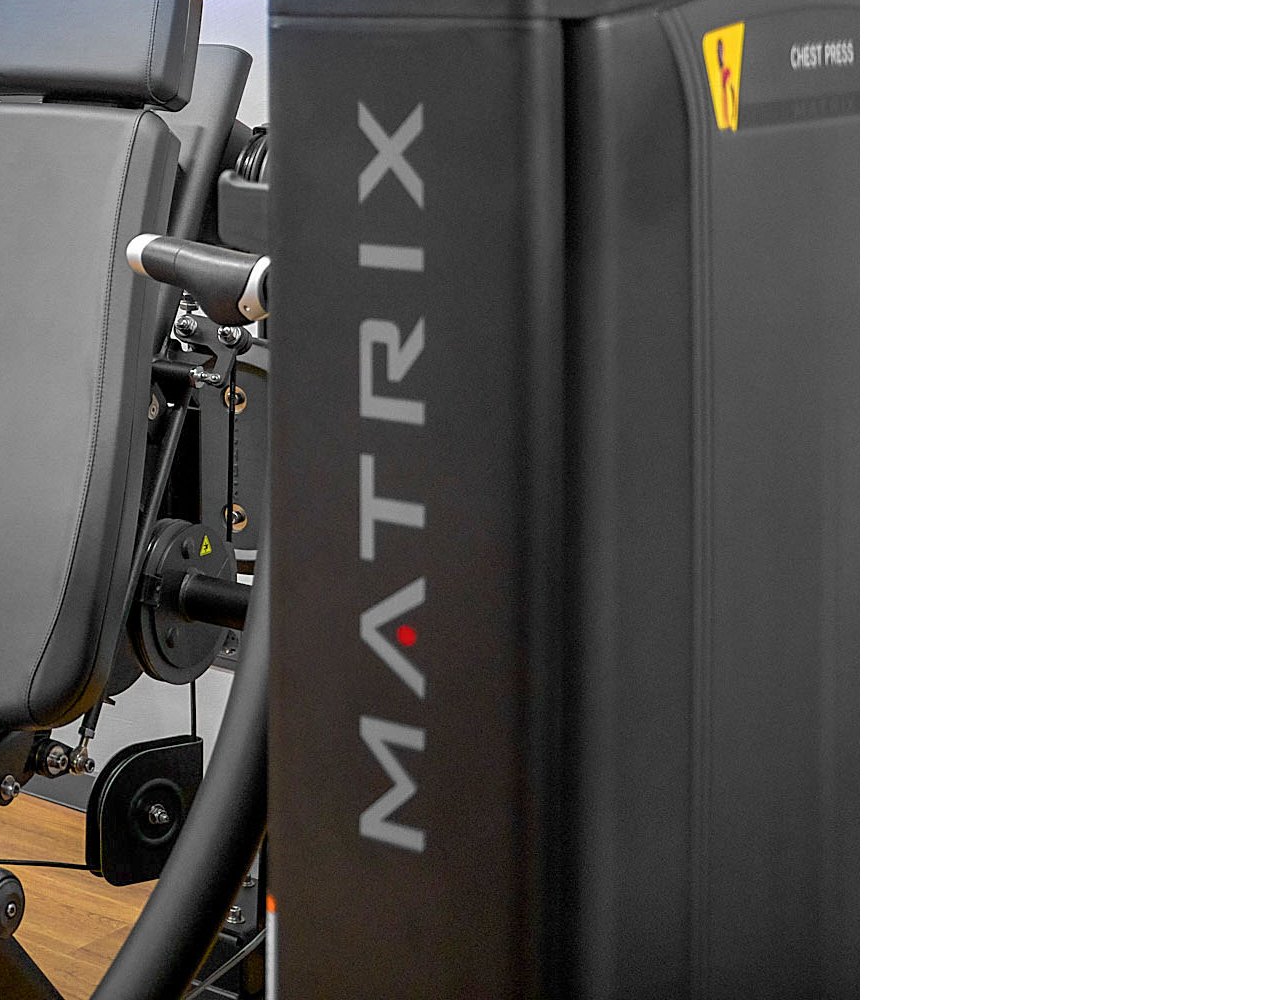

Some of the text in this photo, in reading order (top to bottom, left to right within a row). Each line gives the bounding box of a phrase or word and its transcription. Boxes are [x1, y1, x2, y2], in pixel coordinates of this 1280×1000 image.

[790, 39, 854, 70] CHEST PRESS
[357, 101, 426, 853] MATRIX
